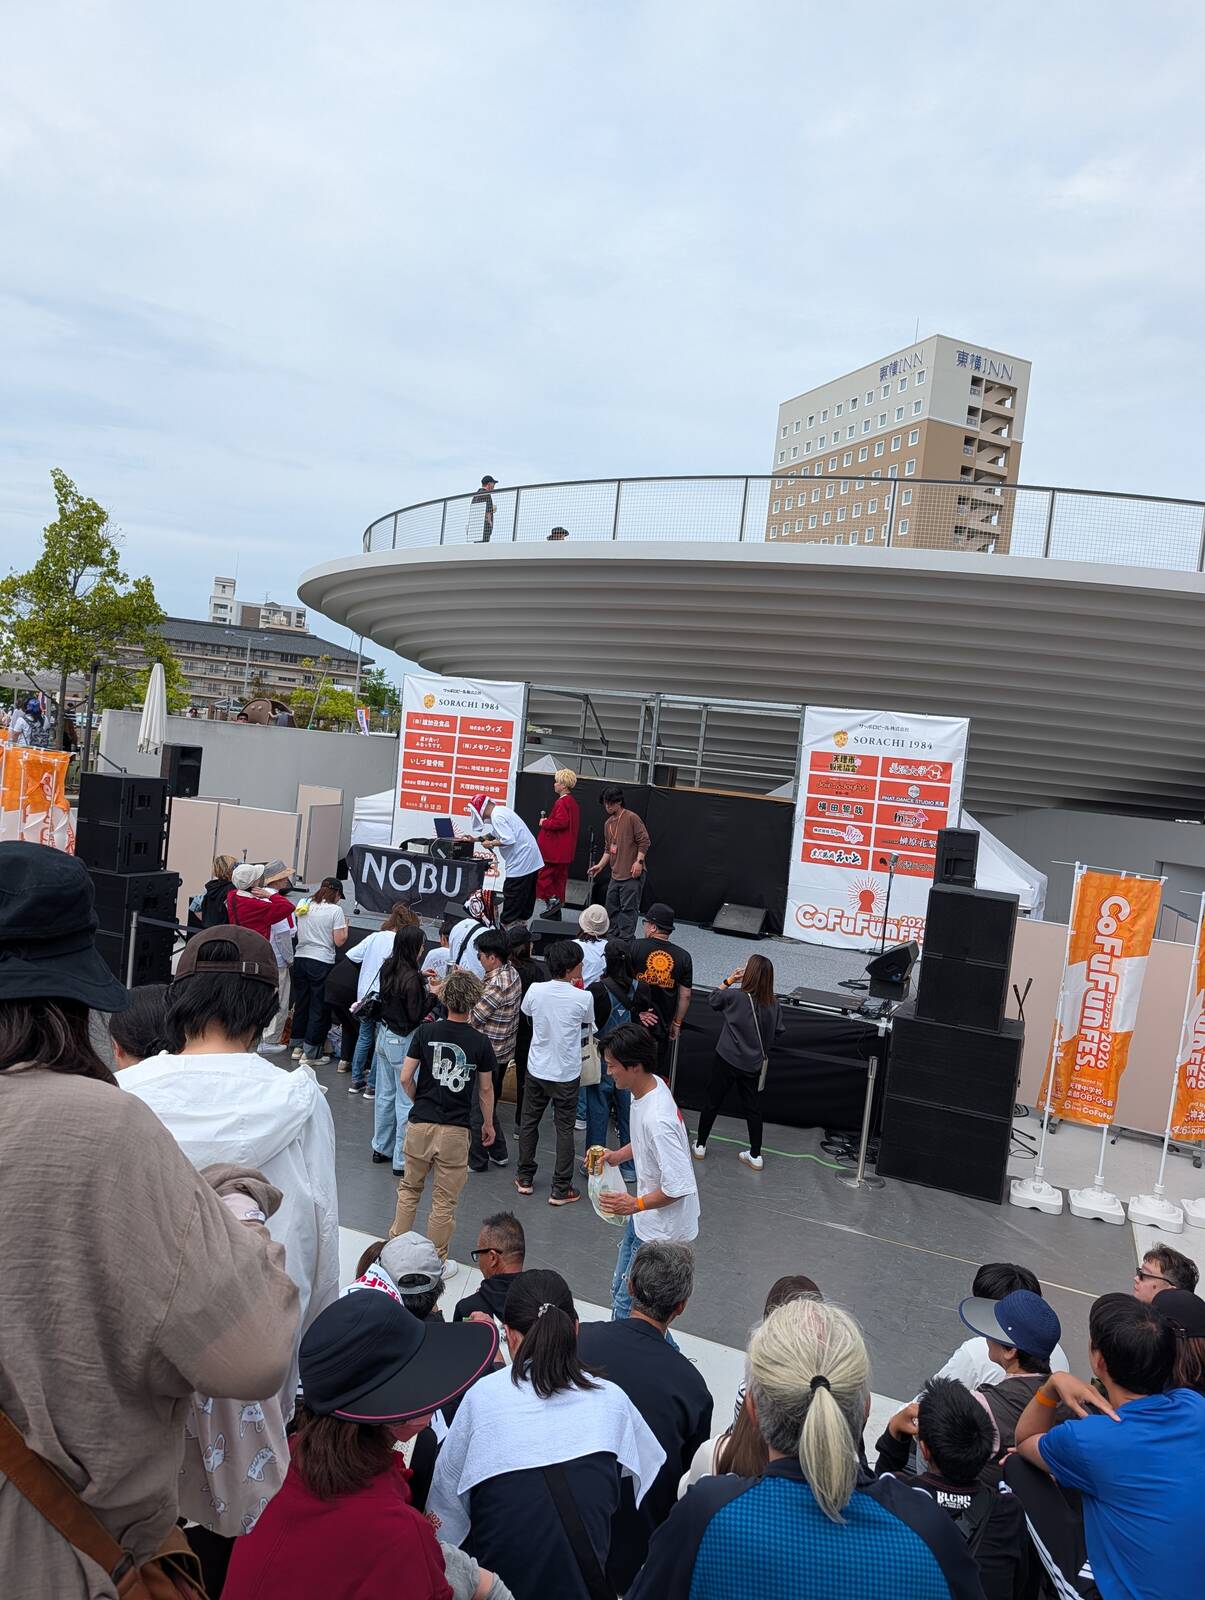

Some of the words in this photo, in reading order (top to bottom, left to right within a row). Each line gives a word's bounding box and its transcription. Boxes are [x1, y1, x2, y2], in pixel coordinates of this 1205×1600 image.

[880, 349, 924, 381] 東横INN
[956, 350, 1013, 381] 東横INN
[439, 699, 478, 709] SORACHI
[481, 702, 499, 711] 1984
[853, 735, 905, 748] SORACHI
[909, 740, 933, 750] 1984
[362, 852, 462, 897] NOBU
[796, 904, 898, 940] CoFuFun
[1081, 894, 1131, 1030] CoFuFun
[1074, 1028, 1101, 1071] FES.
[1097, 1032, 1112, 1070] 2026
